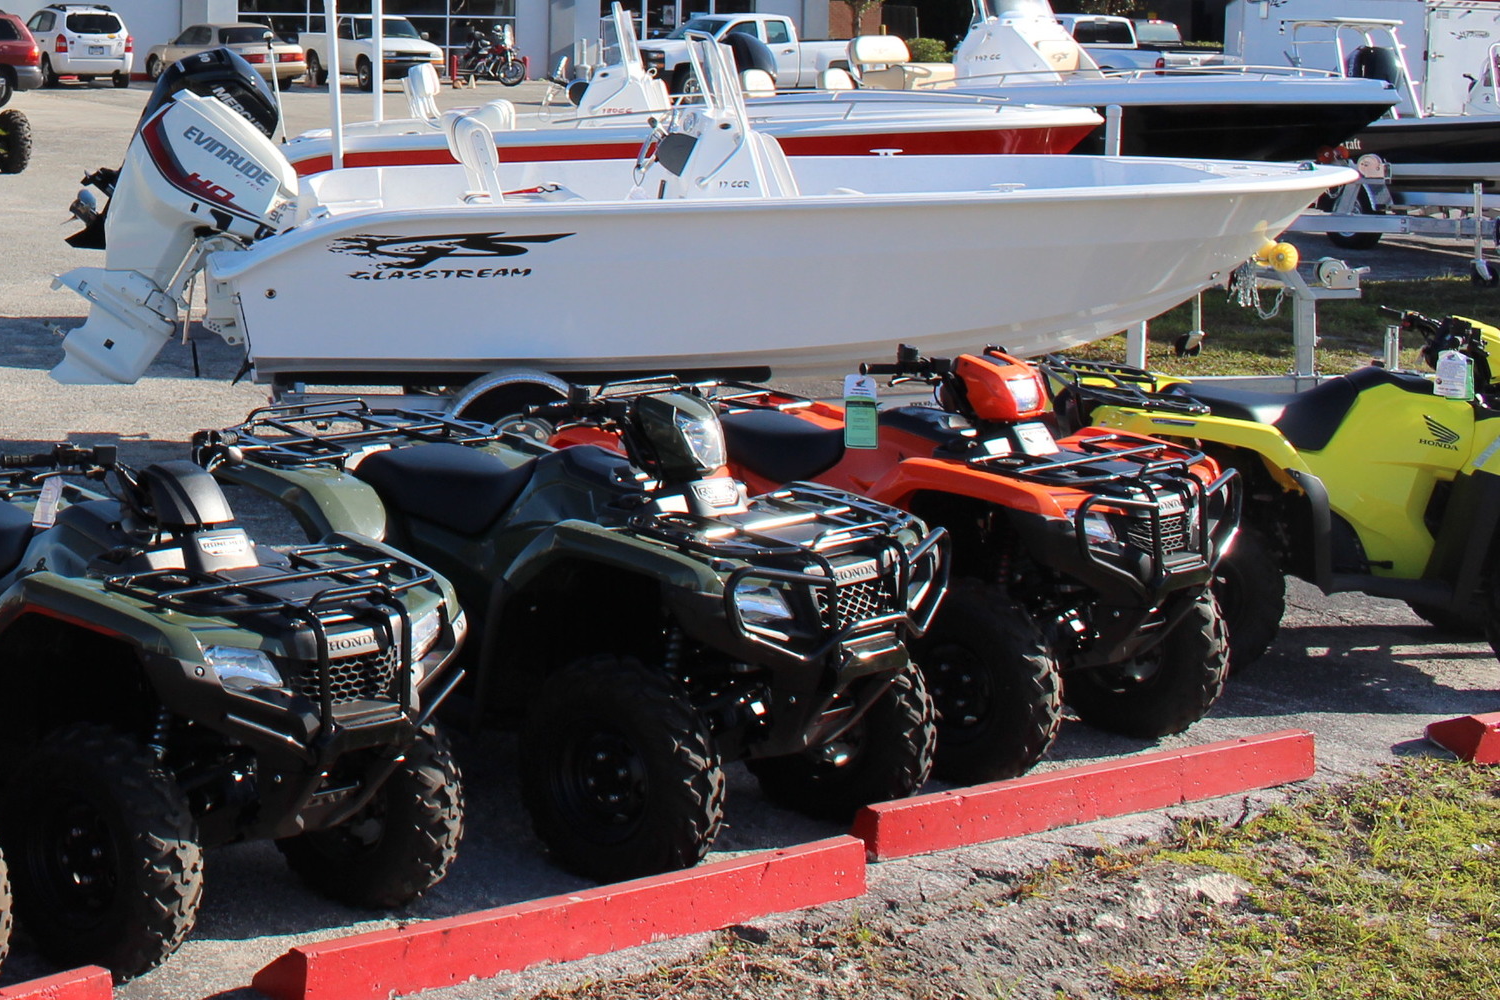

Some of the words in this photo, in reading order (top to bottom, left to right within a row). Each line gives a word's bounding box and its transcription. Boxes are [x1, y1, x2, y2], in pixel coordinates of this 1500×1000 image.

[1340, 137, 1362, 151] raft
[182, 125, 273, 187] EVINRUDE
[347, 268, 532, 280] GLASSTREAM
[1419, 438, 1459, 451] HONDA
[1160, 498, 1181, 511] OND
[835, 564, 877, 582] HONDA
